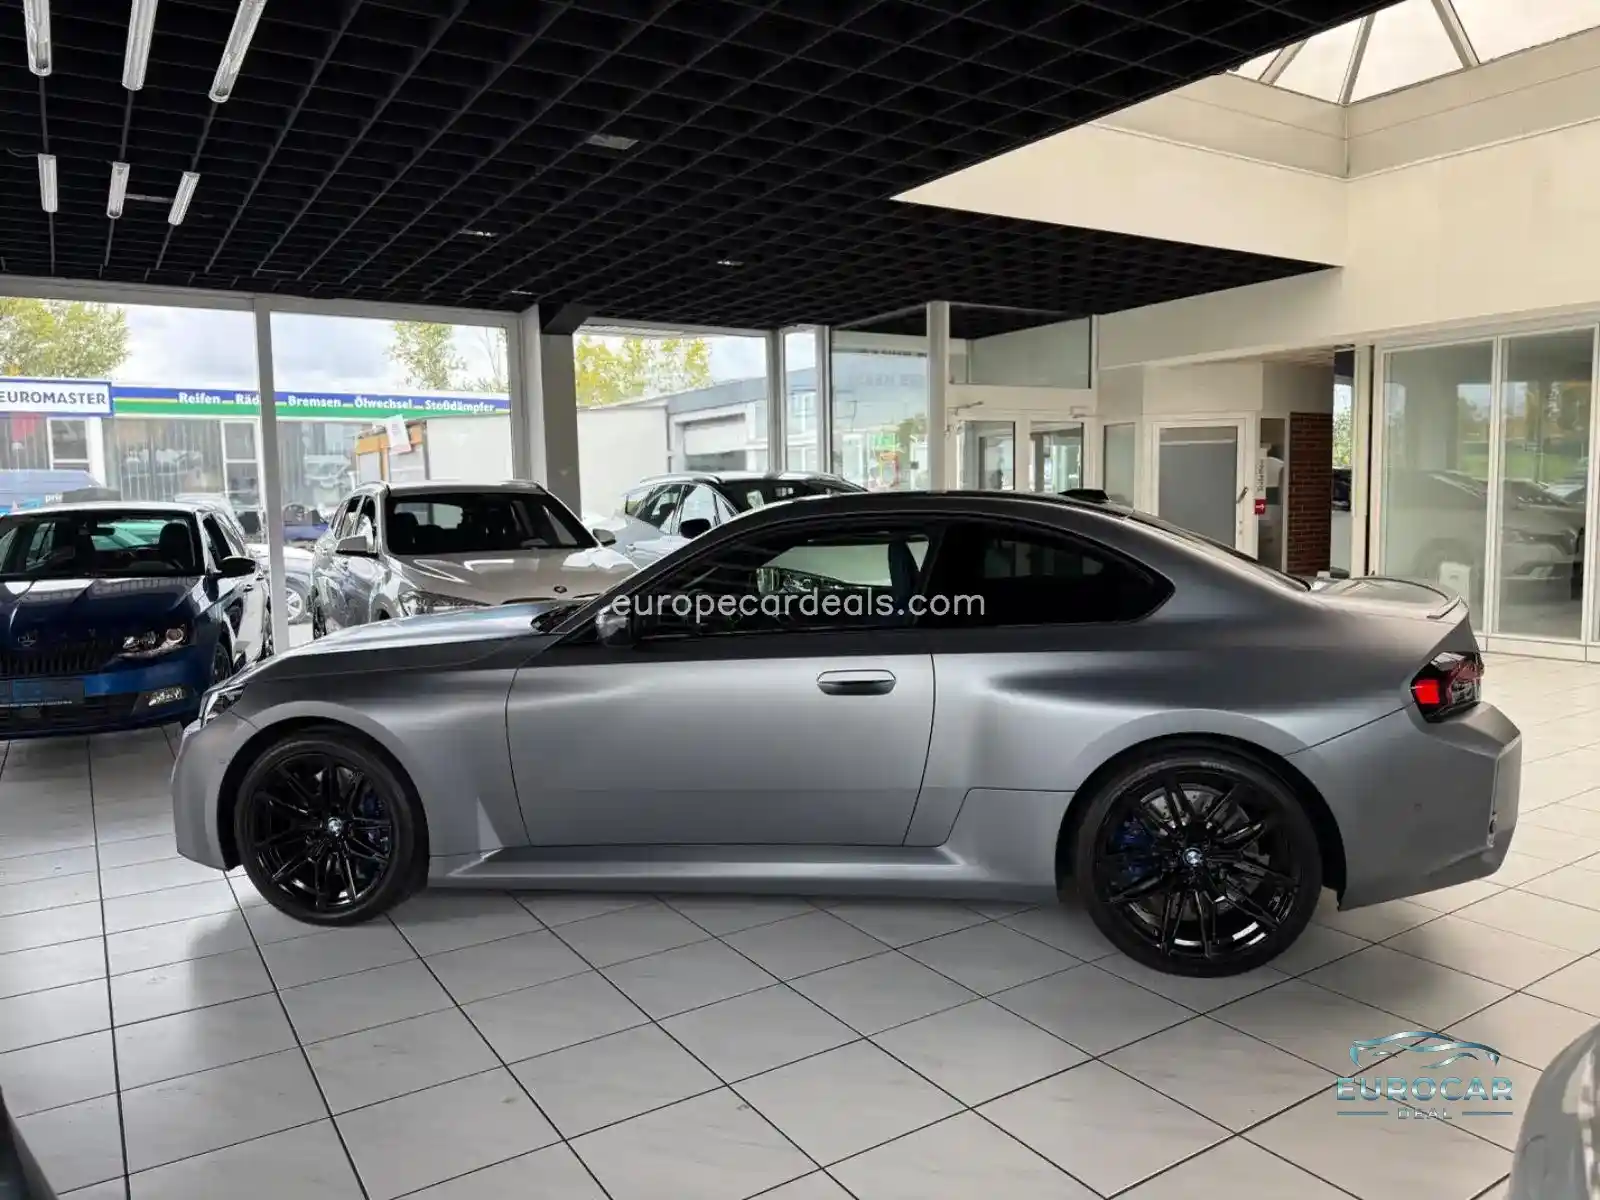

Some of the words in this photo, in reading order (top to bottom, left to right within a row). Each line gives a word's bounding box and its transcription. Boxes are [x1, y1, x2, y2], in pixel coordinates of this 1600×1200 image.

[0, 390, 106, 405] EUROMASTER
[178, 391, 221, 405] Reifen
[235, 392, 261, 406] Räd
[287, 395, 342, 408] Bremsen
[354, 395, 413, 409] Ölwechsel
[424, 399, 496, 414] Stoßdämpfer
